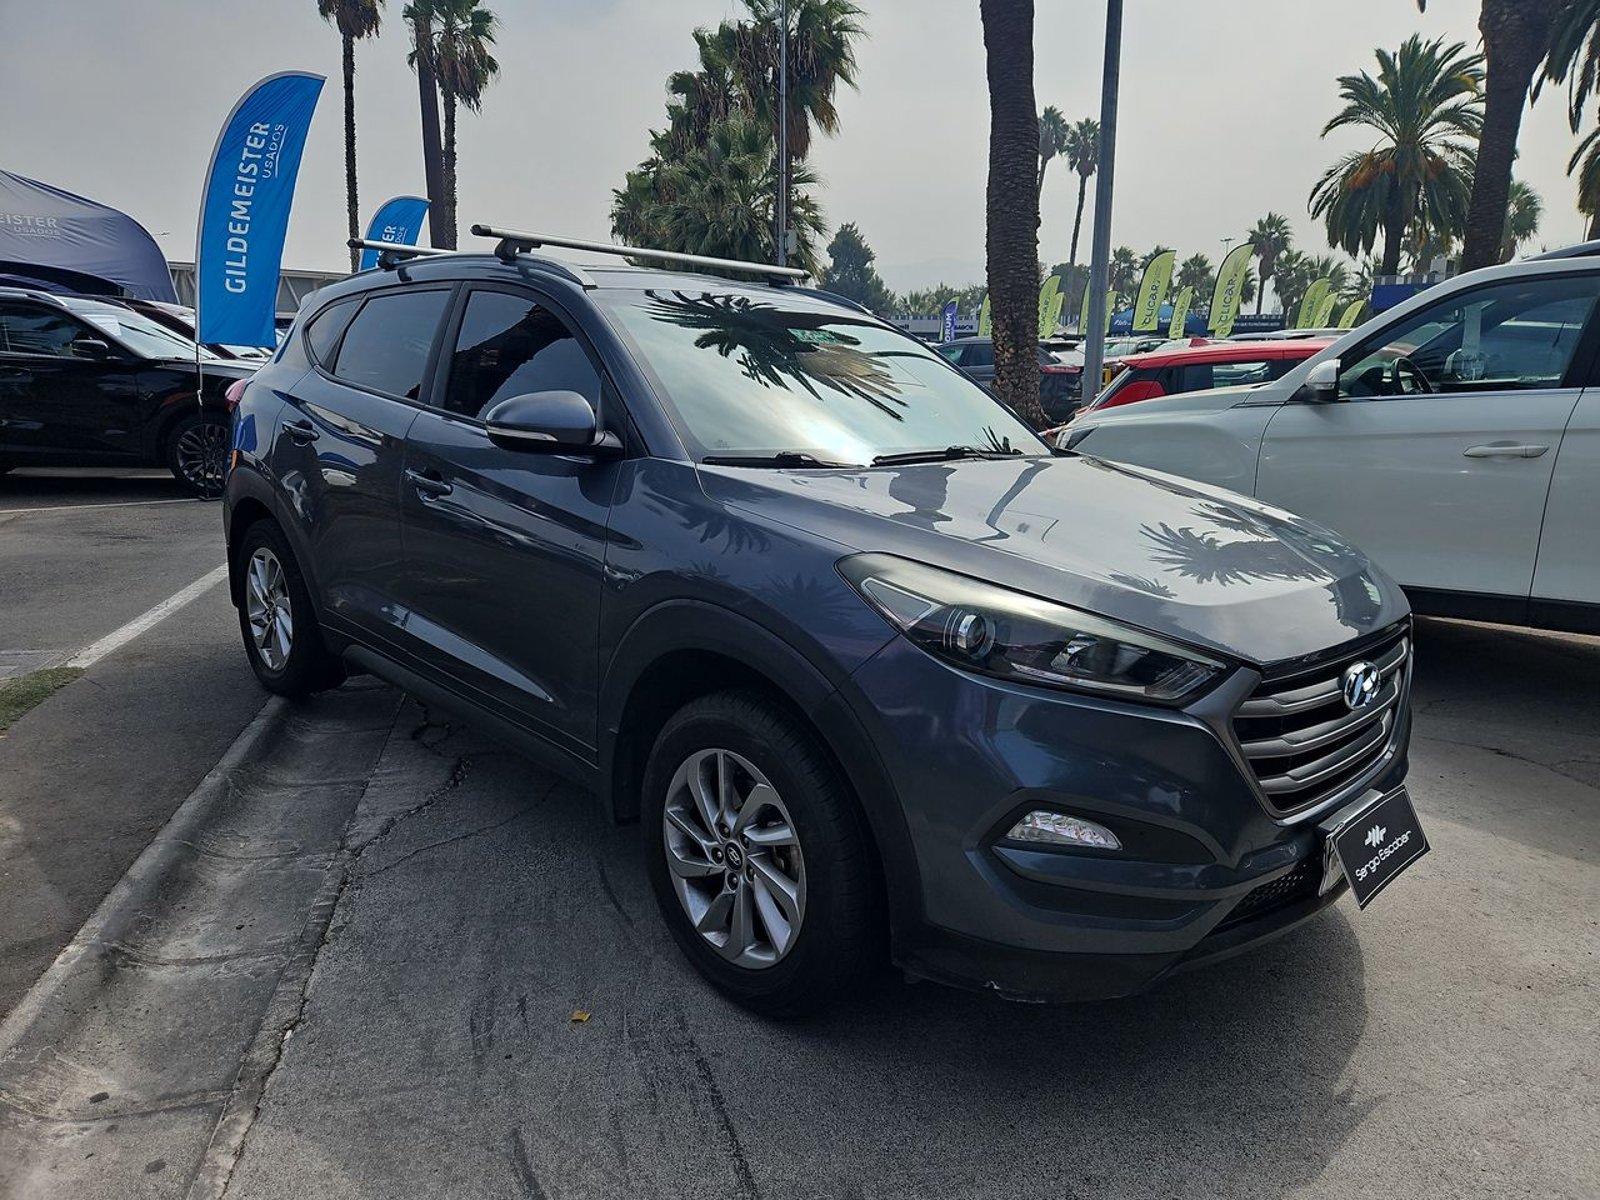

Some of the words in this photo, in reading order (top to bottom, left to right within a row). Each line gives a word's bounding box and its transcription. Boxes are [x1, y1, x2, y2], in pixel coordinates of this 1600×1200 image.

[262, 124, 285, 179] USADOS
[225, 121, 271, 294] GILDEMEISTER
[944, 313, 953, 343] ORUM
